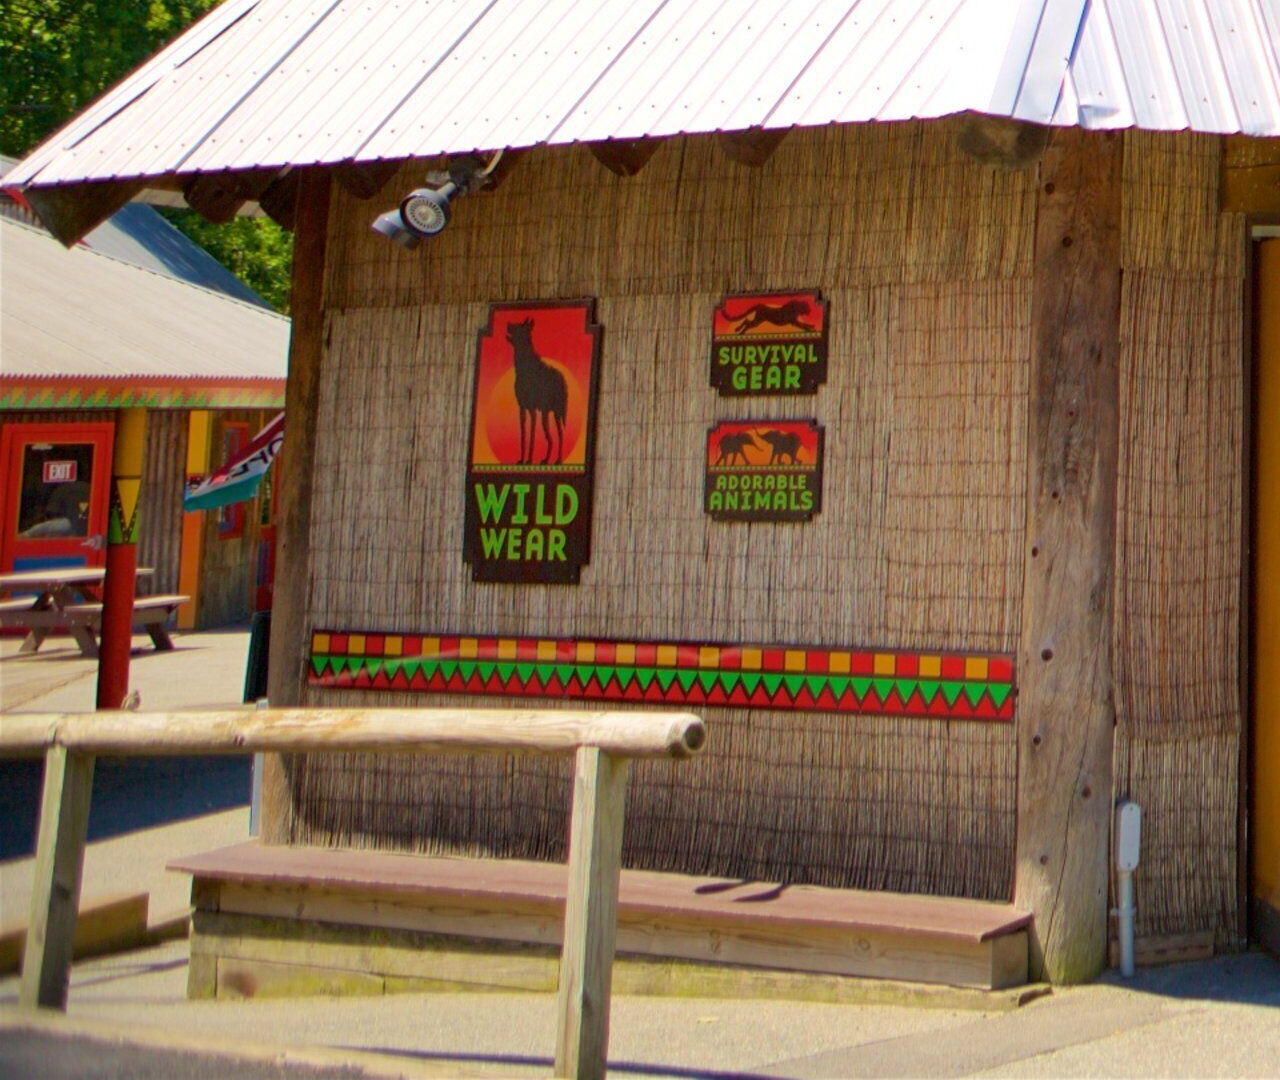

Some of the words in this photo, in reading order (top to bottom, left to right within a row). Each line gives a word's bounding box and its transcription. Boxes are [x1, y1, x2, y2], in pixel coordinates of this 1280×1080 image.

[718, 344, 818, 365] SURVIVAL
[731, 366, 802, 390] GEAR
[49, 463, 72, 480] EXIT
[716, 475, 807, 491] ADORABLE
[474, 484, 579, 525] WILD
[709, 491, 813, 511] ANIMALS
[480, 528, 567, 561] WEAR
